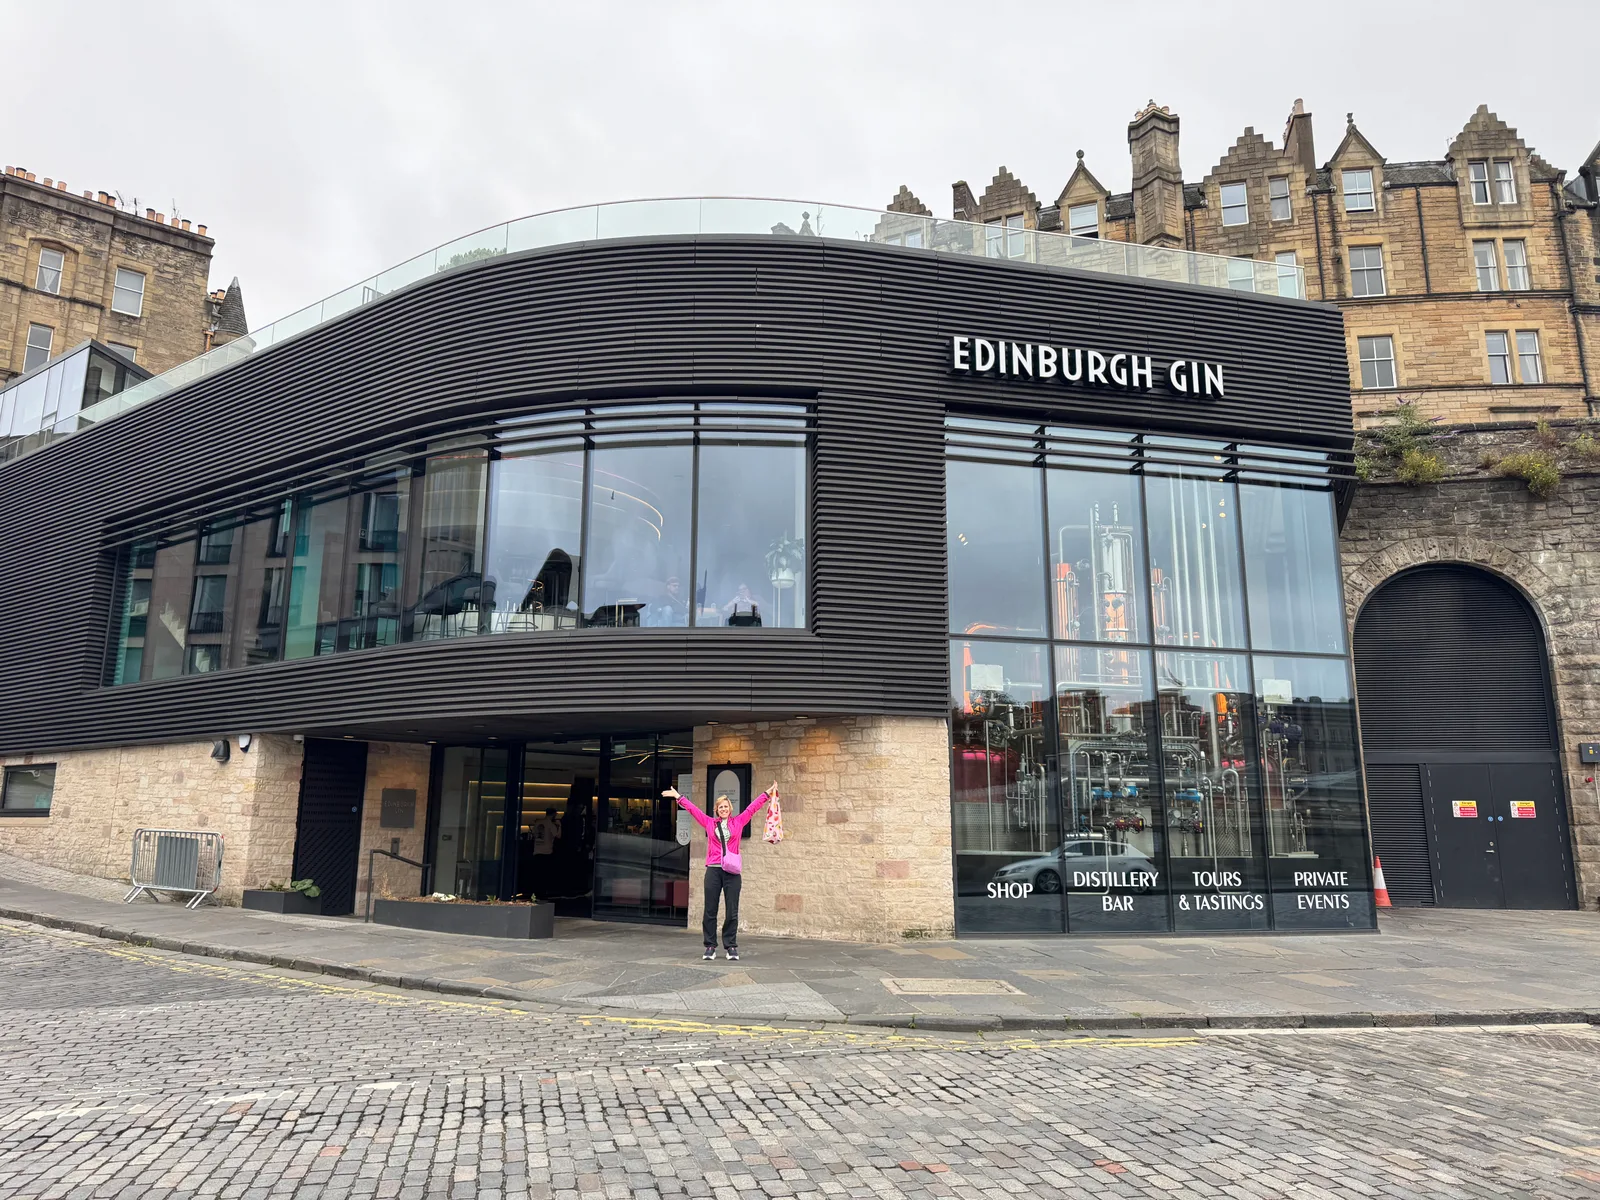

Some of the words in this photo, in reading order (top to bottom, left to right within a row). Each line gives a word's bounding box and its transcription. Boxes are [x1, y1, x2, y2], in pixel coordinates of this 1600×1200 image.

[953, 336, 1153, 388] EDINBURGH
[1169, 361, 1225, 396] GIN
[1073, 871, 1159, 888] DISTILLERY
[1192, 871, 1242, 888] TOURS
[1294, 871, 1349, 887] PRIVATE
[987, 882, 1034, 899] SHOP
[1102, 895, 1134, 912] BAR
[1178, 894, 1191, 911] &
[1194, 894, 1264, 911] TASTINGS
[1297, 894, 1350, 910] EVENTS
